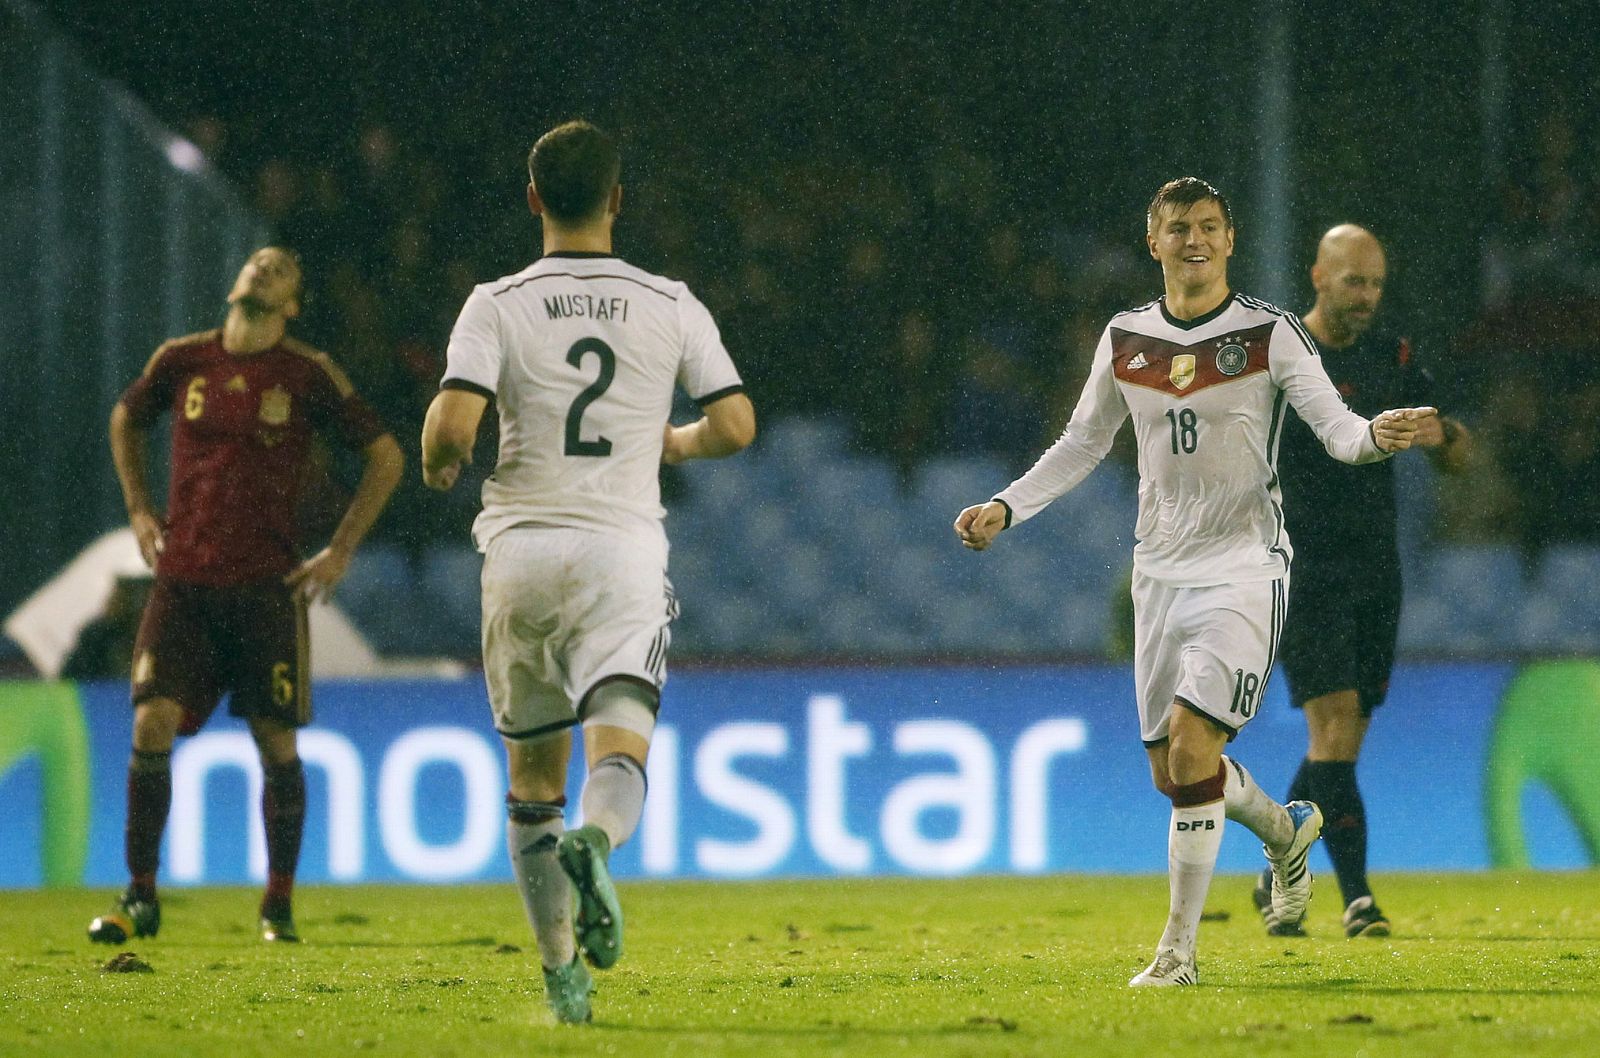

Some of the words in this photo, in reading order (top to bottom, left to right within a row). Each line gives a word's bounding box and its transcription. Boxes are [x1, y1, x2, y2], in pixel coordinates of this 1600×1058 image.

[543, 294, 628, 322] MUSTAFI
[184, 376, 205, 420] 6
[564, 337, 616, 456] 2
[1165, 408, 1198, 454] 18
[272, 662, 292, 704] 6
[1229, 668, 1259, 718] 18
[167, 694, 1089, 881] moistar
[1176, 819, 1215, 832] DFB
